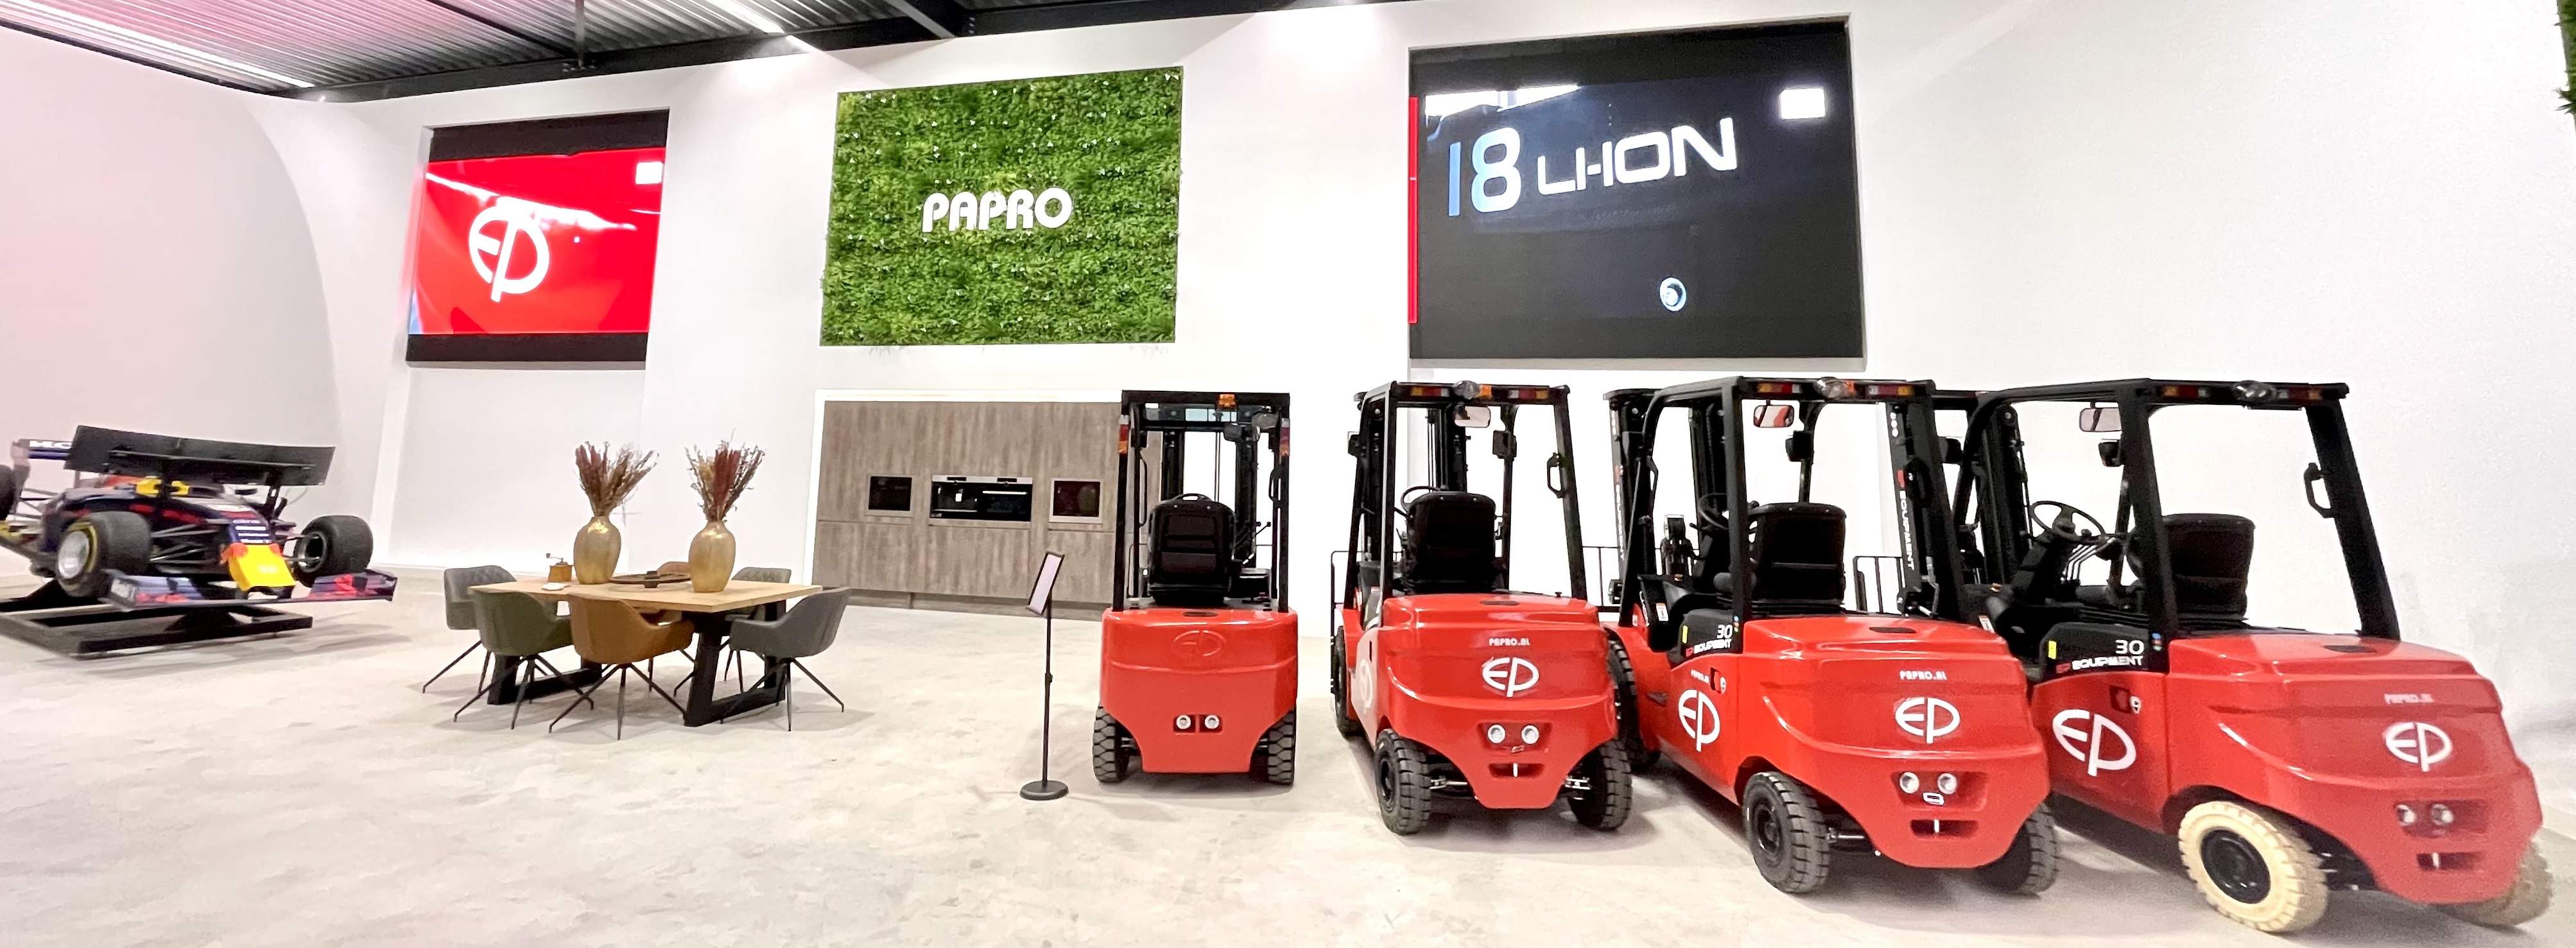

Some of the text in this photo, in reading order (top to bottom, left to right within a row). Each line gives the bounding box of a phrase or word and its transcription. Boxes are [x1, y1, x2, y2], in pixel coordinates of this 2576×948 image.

[1537, 117, 1737, 195] LI-ION
[922, 187, 1073, 232] PAPRO
[469, 203, 550, 304] EP
[1717, 624, 1733, 639] 30
[2116, 640, 2144, 655] 30
[1482, 657, 1539, 698] EP
[2071, 656, 2143, 670] EQUIPMENT
[1678, 689, 1720, 752] EP
[1895, 697, 1960, 744] EP
[2052, 709, 2136, 777] EP
[2385, 722, 2452, 772] EP
